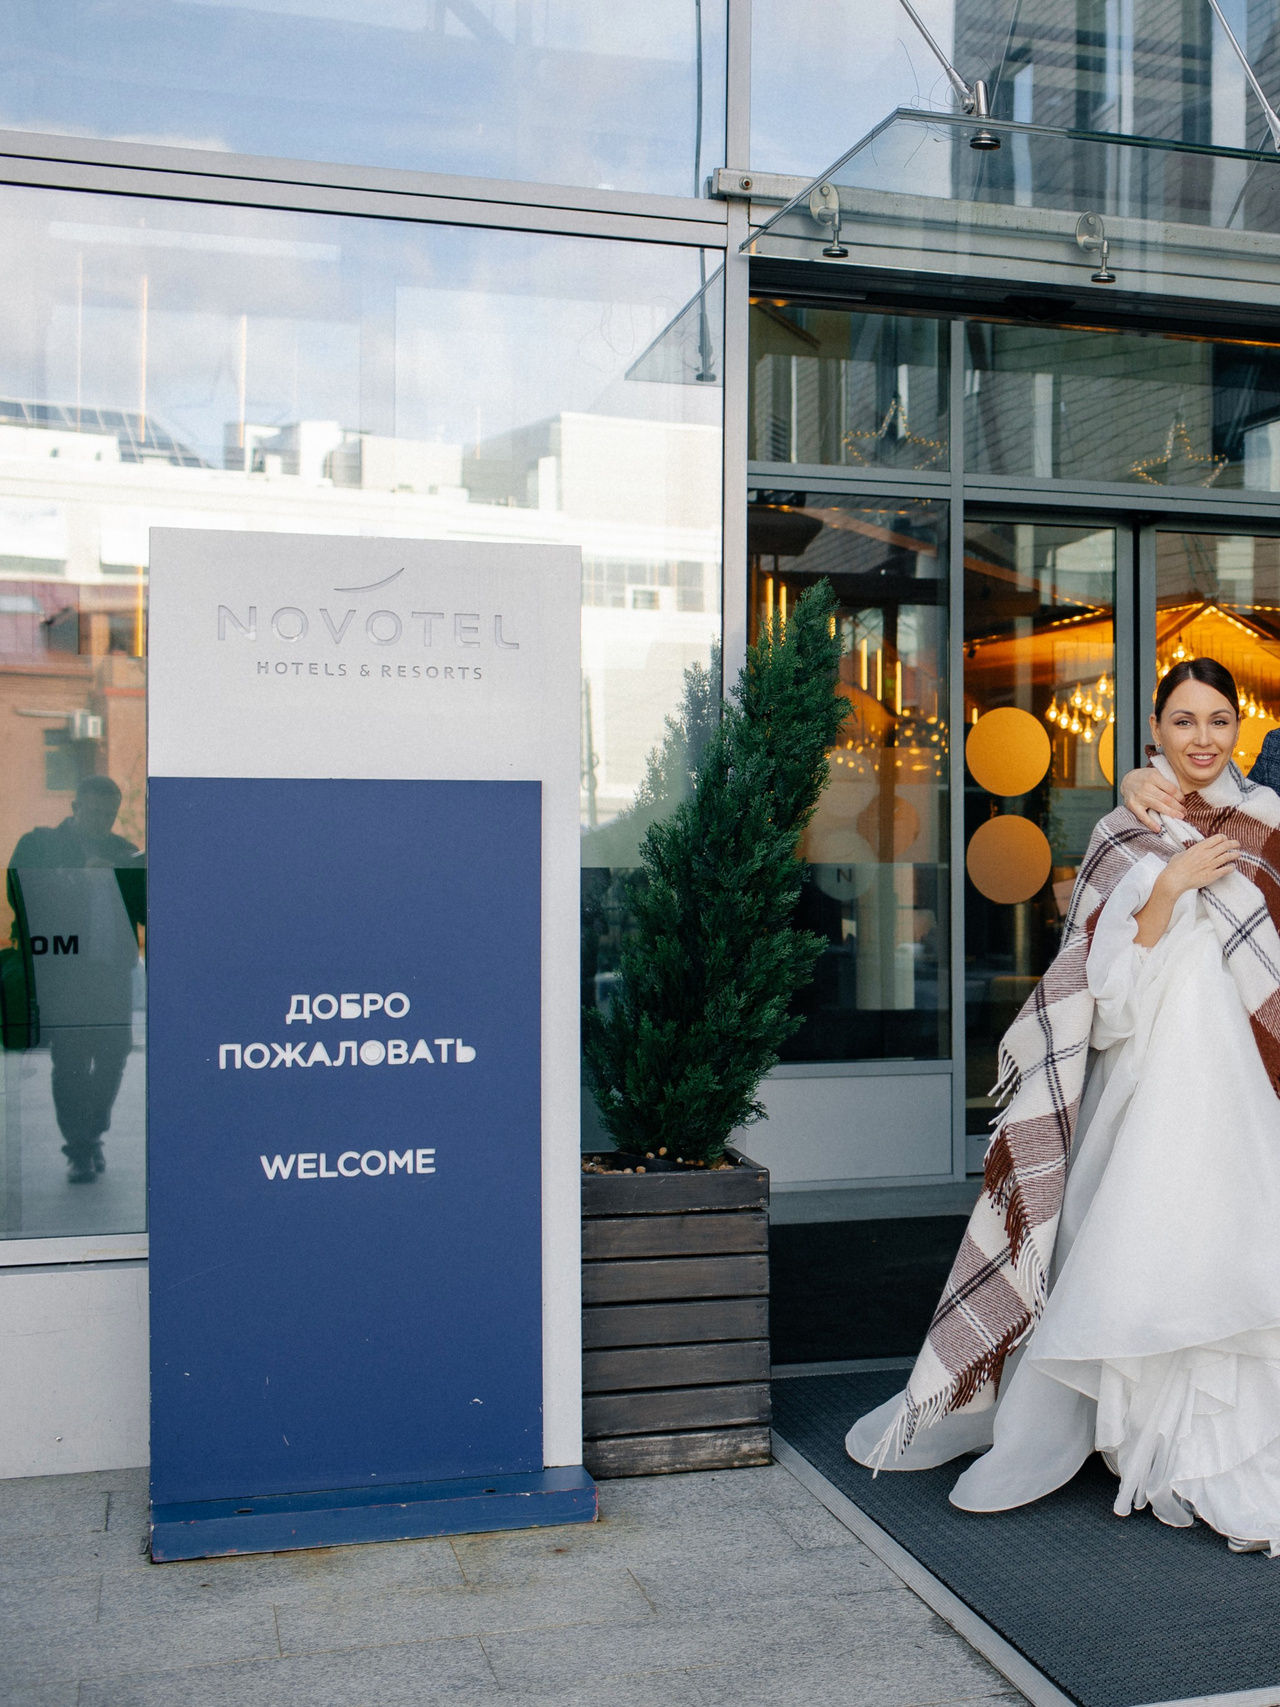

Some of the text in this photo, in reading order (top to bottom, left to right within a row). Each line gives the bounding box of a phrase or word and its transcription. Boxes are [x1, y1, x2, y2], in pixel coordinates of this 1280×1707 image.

[217, 604, 520, 650] NOVOTEL
[256, 660, 483, 680] HOTELS & RESORTS
[285, 991, 411, 1025] ДОБРО
[218, 1037, 477, 1070] ПОЖАЛОВАТЬ
[259, 1148, 437, 1181] WELCOME
